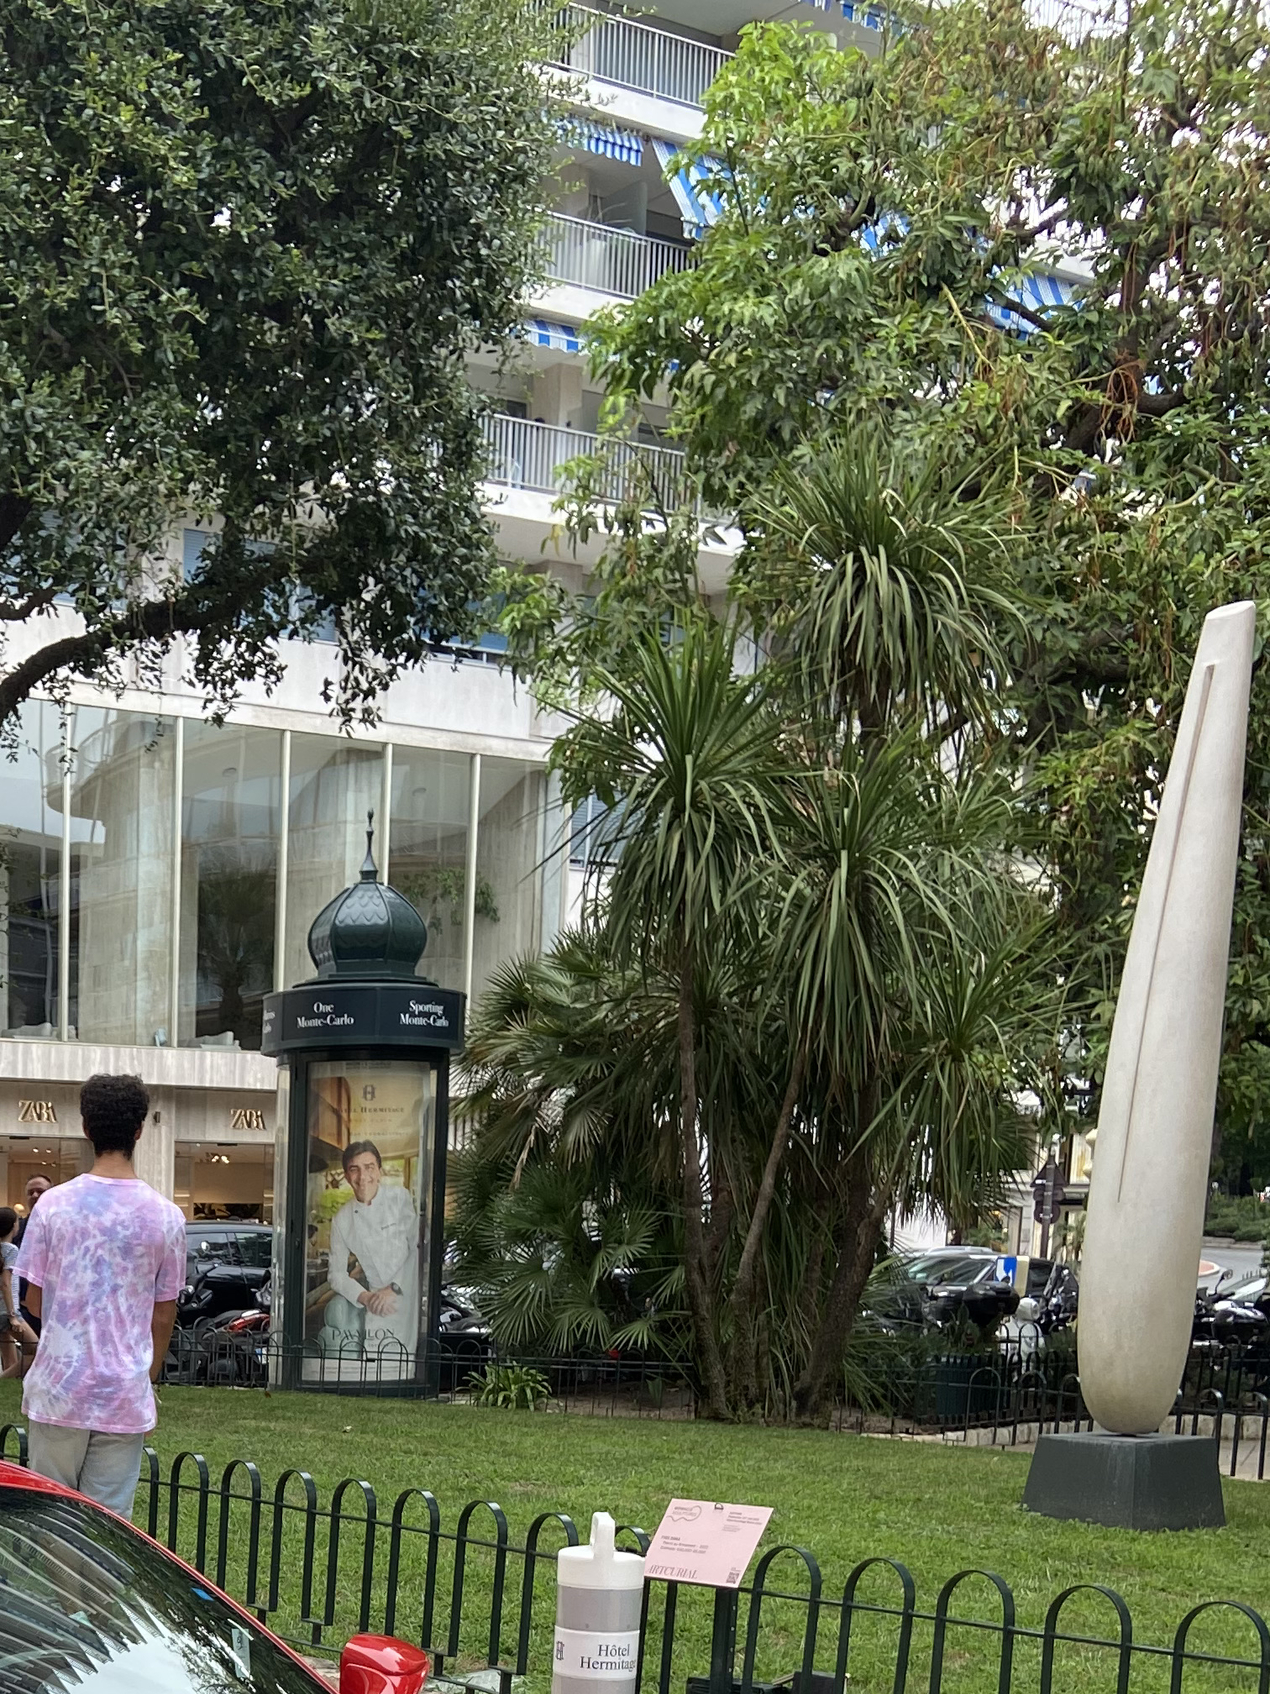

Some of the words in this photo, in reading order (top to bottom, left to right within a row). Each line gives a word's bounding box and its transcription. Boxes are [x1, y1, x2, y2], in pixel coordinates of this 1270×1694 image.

[312, 1001, 335, 1013] One
[409, 1000, 445, 1016] Sporting
[296, 1013, 355, 1029] Monte-Carlo
[399, 1012, 449, 1028] Monte-Carlo
[17, 1099, 57, 1124] ZARA
[230, 1108, 266, 1131] ZARA
[649, 1564, 698, 1579] ARTCURIAL
[598, 1643, 631, 1658] Hôtel
